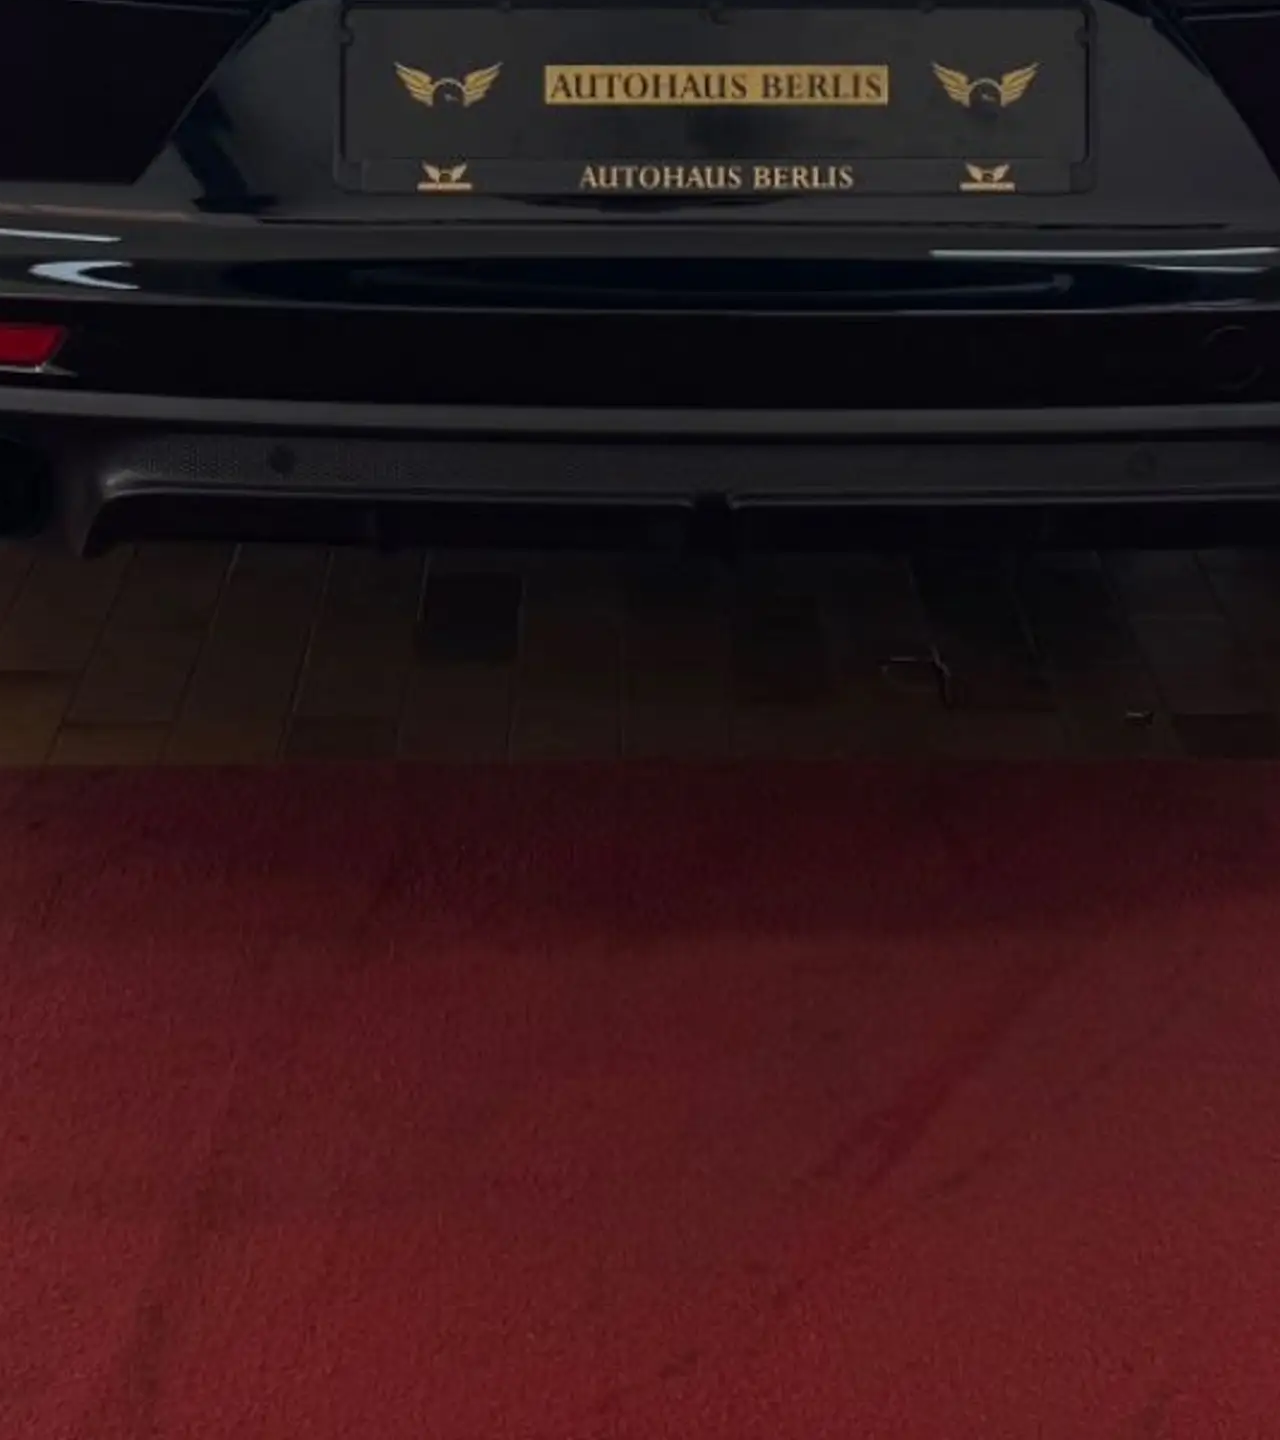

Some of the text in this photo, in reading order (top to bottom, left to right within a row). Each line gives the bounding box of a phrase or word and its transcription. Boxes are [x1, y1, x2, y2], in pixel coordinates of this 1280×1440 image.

[550, 72, 883, 99] AUTOHAUS BERLIS
[579, 165, 854, 190] AUTOHAUS BERLIS
